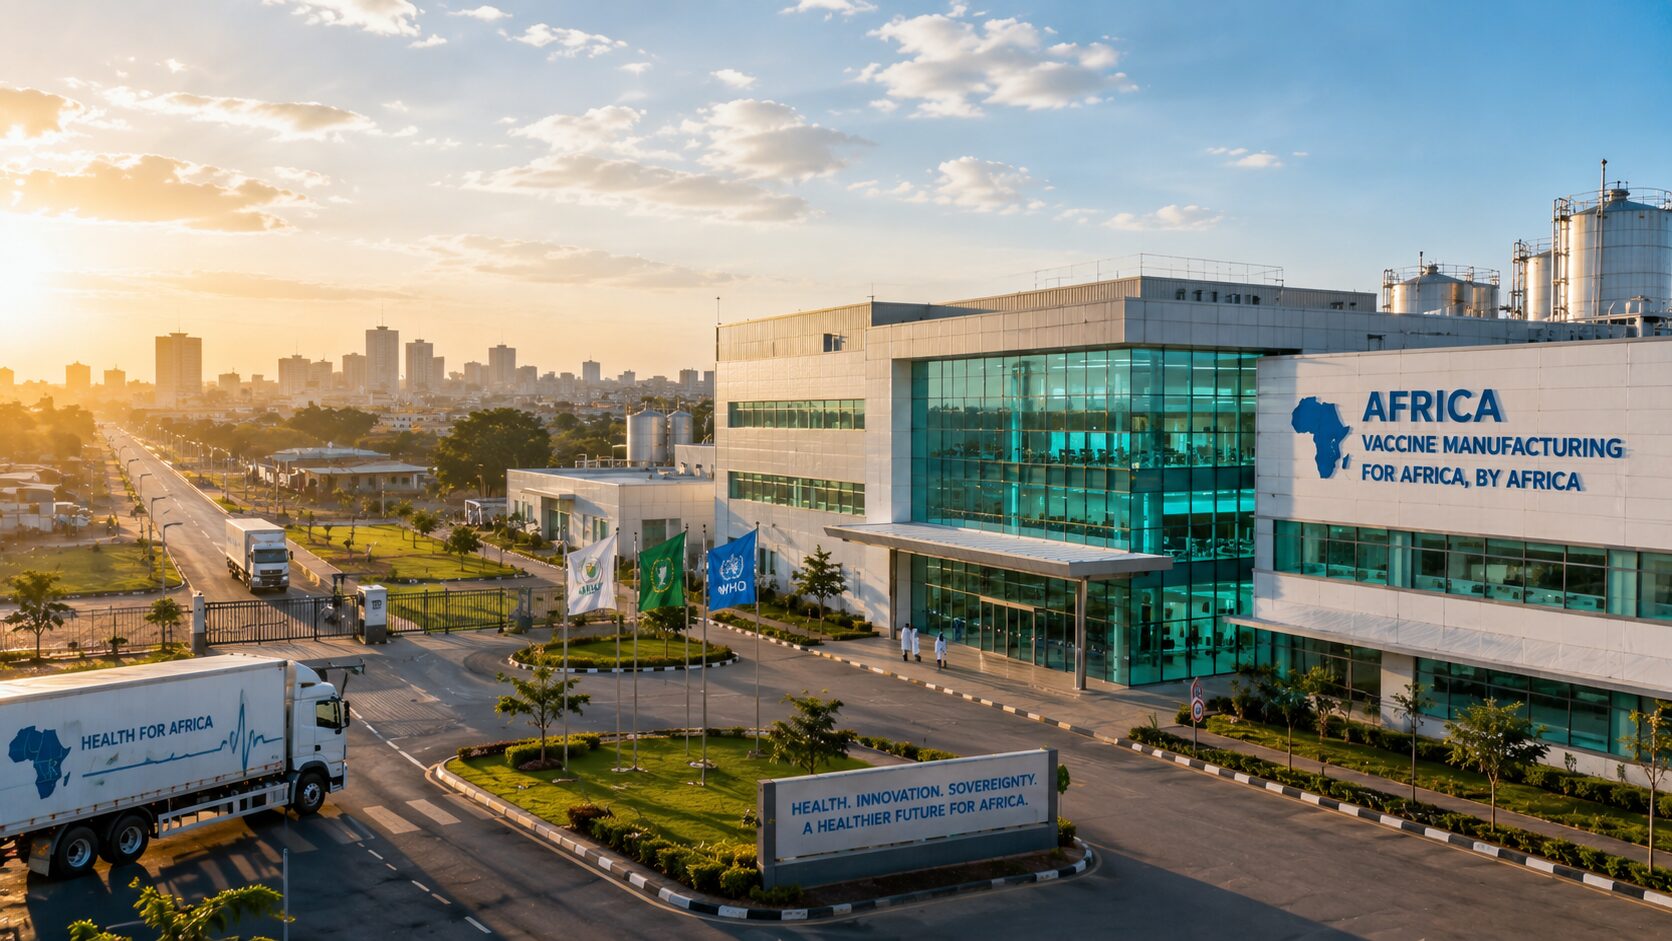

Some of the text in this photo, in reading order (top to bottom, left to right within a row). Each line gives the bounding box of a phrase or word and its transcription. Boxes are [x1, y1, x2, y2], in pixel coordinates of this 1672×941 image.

[1362, 389, 1503, 423] AFRICA
[1362, 434, 1623, 459] VACCINE MANUFACTURING
[1362, 464, 1582, 492] FOR AFRICA, BY AFRICA
[717, 580, 747, 595] WHO
[81, 715, 214, 751] HEALTH FOR AFRICA
[791, 773, 1037, 816] HEALTH. INNOVATION. SOVEREIGNTY.
[802, 793, 1029, 836] A HEALTHIER FUTURE FOR AFRICA.
